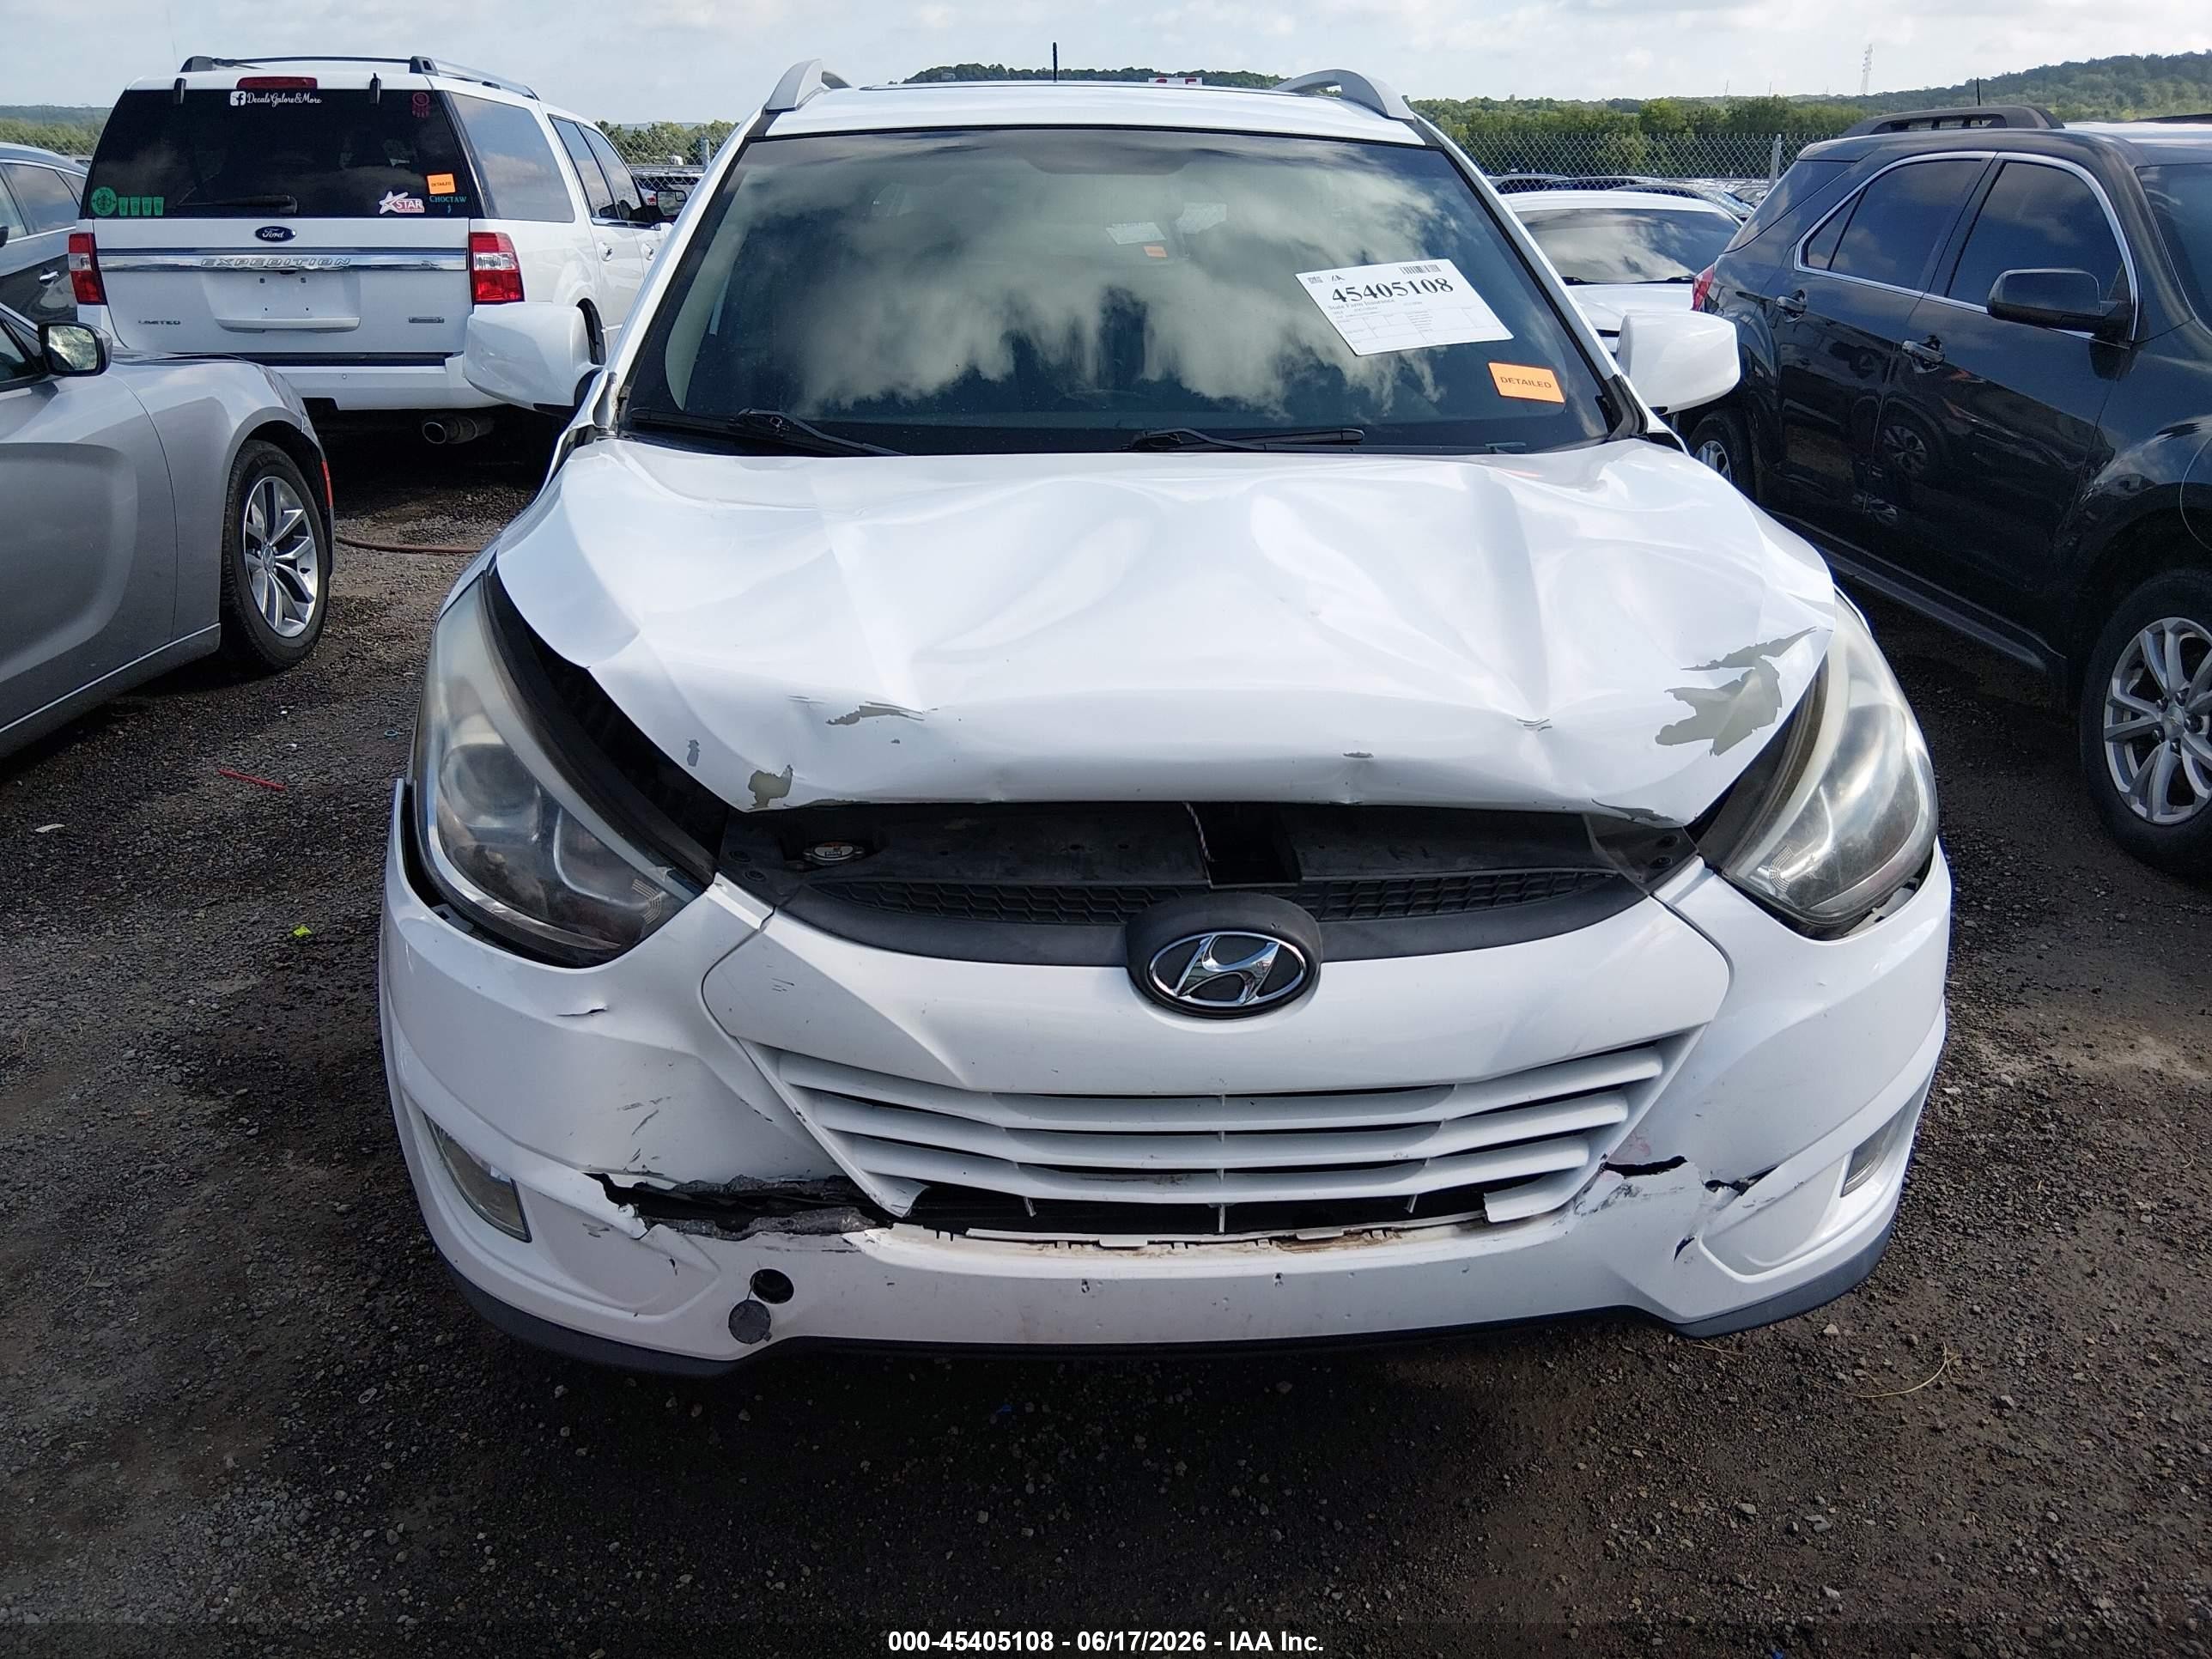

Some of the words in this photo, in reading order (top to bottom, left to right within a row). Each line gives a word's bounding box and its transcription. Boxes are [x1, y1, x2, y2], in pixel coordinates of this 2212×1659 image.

[397, 200, 422, 209] STAR
[262, 228, 284, 238] Ford
[200, 258, 351, 267] EXPEDITION
[1332, 277, 1454, 303] 45405108
[1365, 298, 1395, 307] Insurance
[1499, 376, 1552, 388] DETAILED
